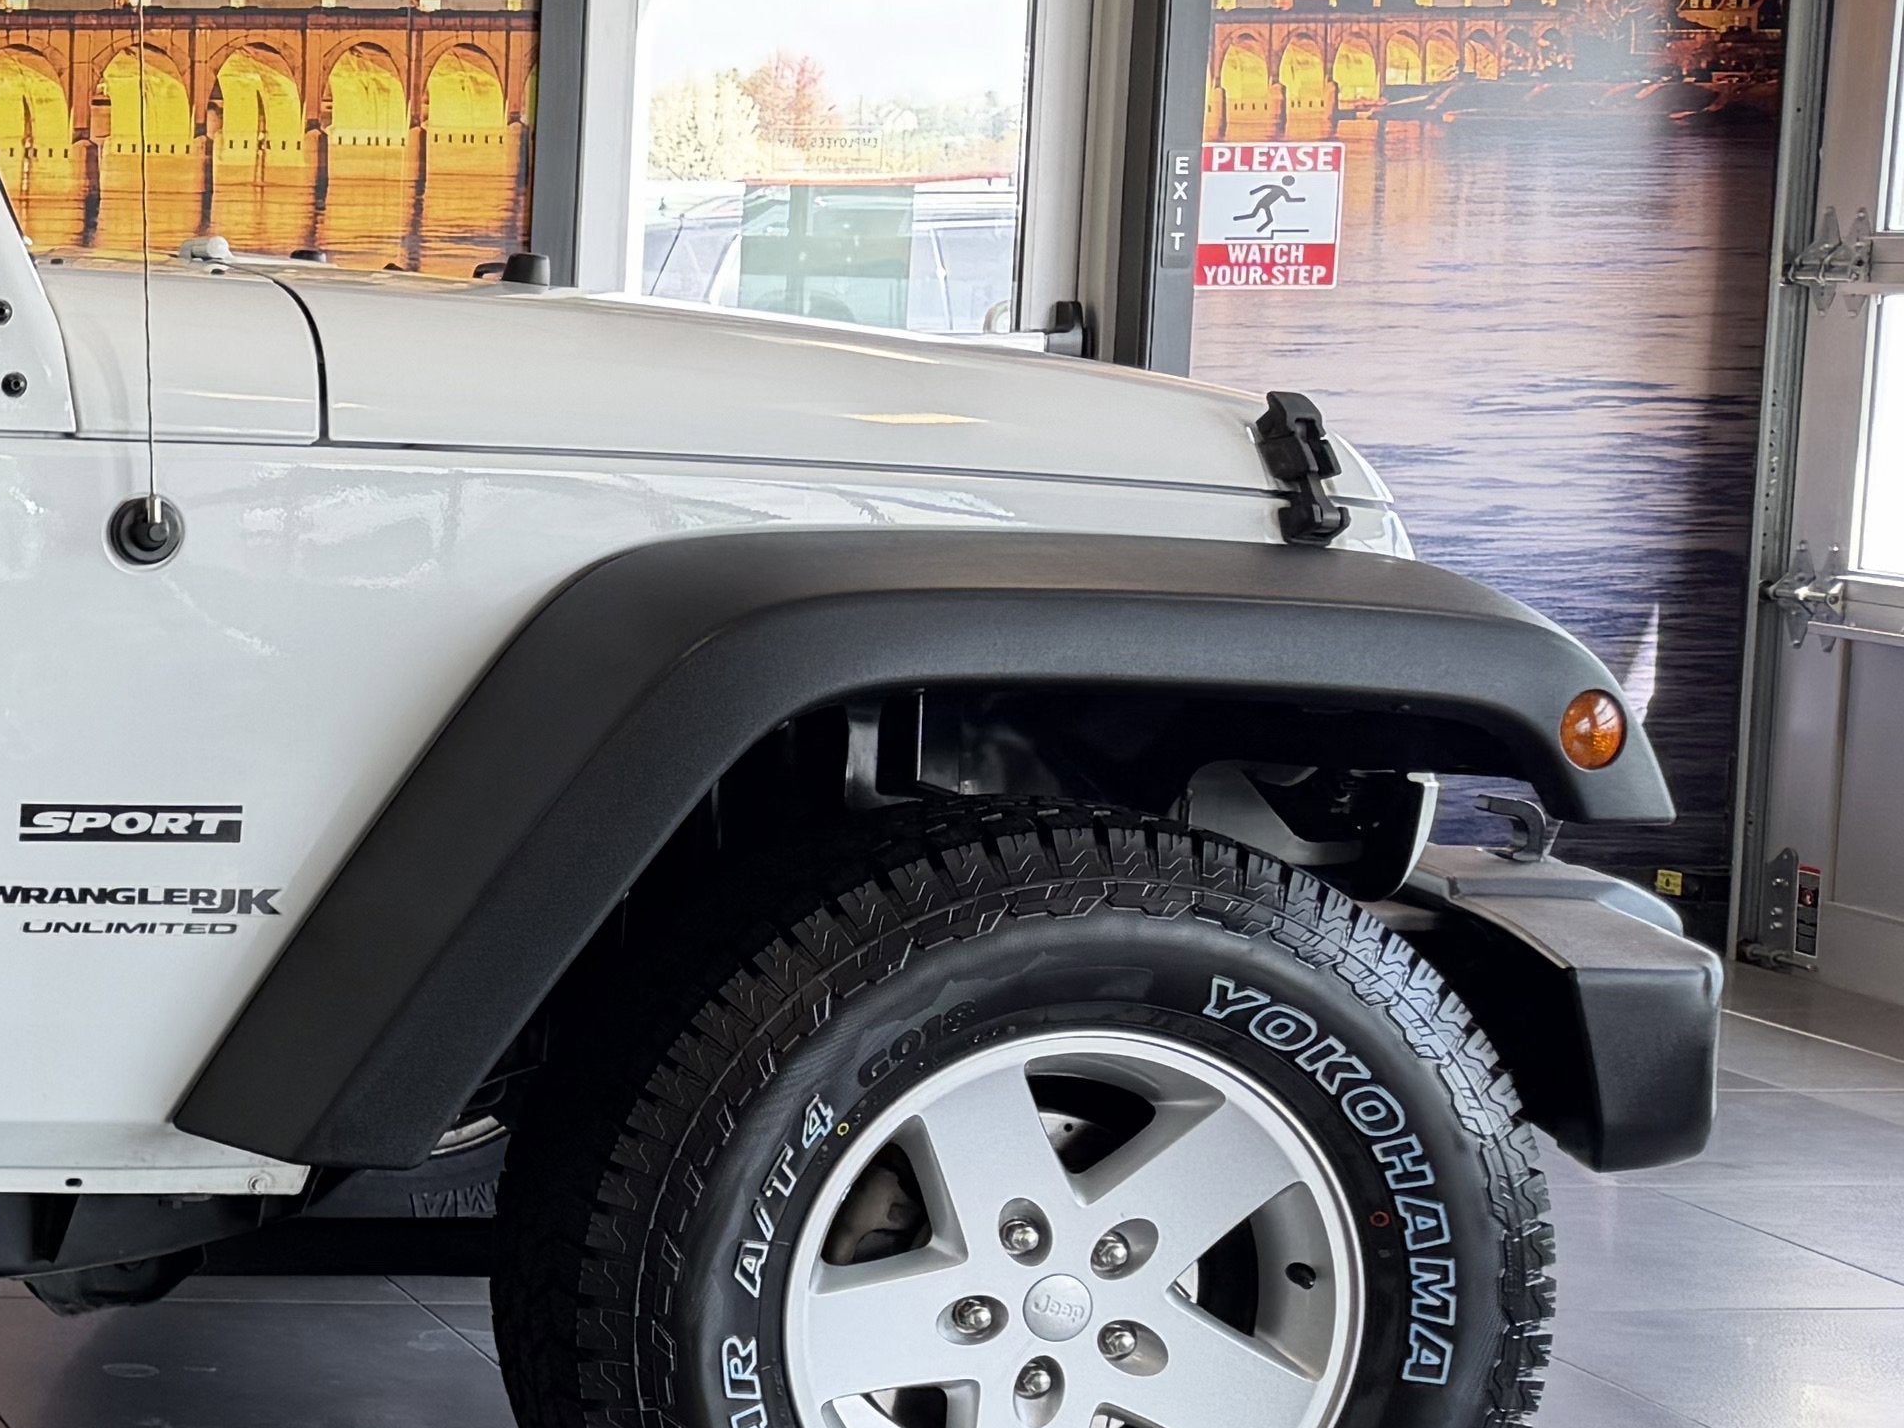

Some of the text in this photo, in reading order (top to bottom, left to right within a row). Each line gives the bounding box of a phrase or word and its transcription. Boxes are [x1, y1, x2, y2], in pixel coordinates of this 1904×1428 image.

[1211, 146, 1334, 172] PLEASE
[1169, 156, 1190, 252] EXIT
[1227, 243, 1305, 265] WATCH
[1202, 265, 1327, 285] YOUR STEP
[24, 809, 242, 838] SPORT
[21, 921, 237, 936] UNLIMITED
[1201, 973, 1457, 1387] YOKOHAMA
[1030, 1294, 1086, 1324] Jeep
